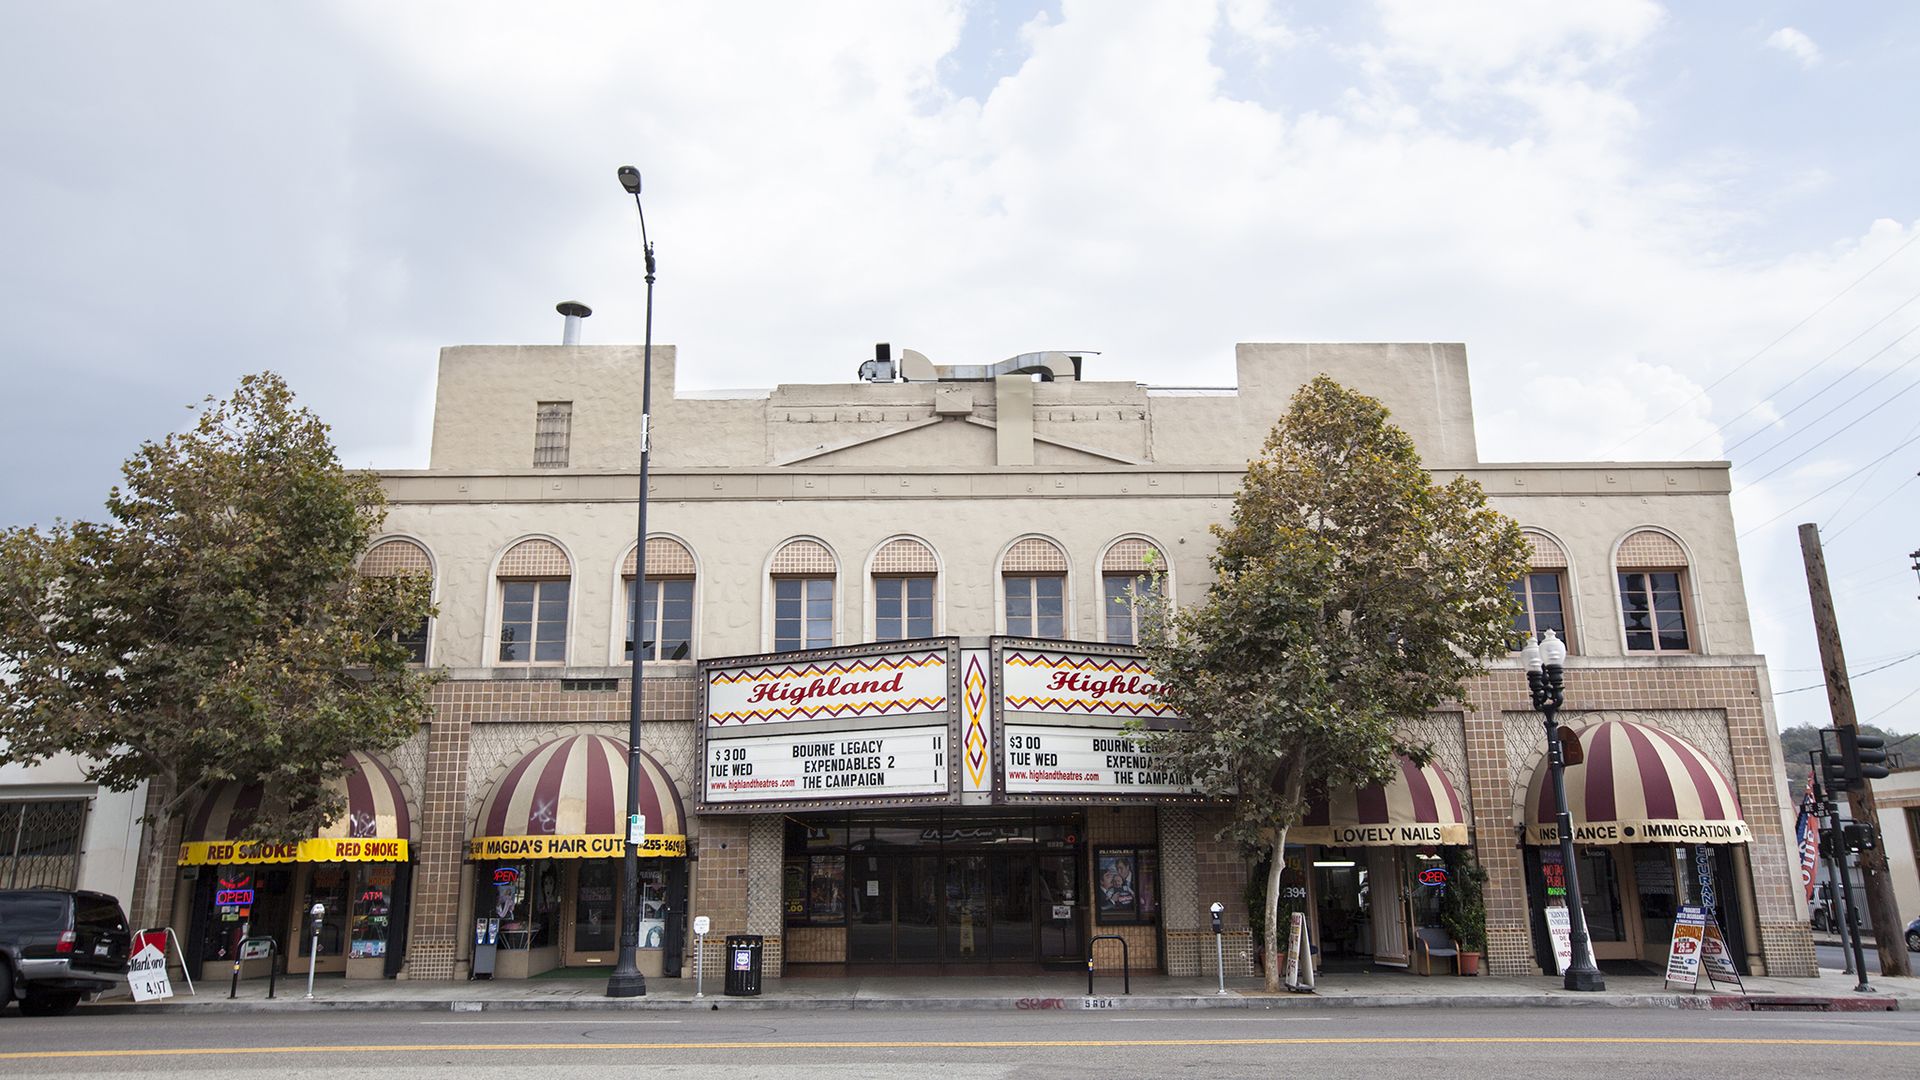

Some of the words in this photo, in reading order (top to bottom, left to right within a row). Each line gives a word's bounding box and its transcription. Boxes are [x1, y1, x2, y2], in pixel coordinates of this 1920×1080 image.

[747, 672, 904, 706] Highland
[1047, 671, 1174, 699] Highlan
[793, 743, 835, 758] BOURNE
[841, 740, 883, 755] LEGACY
[1093, 739, 1134, 753] BOURNE
[805, 756, 881, 773] EXPENDABLES
[888, 755, 895, 769] 2
[1010, 752, 1031, 765] TUE
[1035, 753, 1058, 767] WED
[1106, 755, 1162, 769] EXPENDA
[710, 765, 728, 777] TUE
[732, 763, 753, 776] WED
[803, 775, 822, 789] THE
[825, 772, 885, 788] CAMPAIGN
[1114, 771, 1133, 784] THE
[1138, 772, 1194, 785] CAMPAIGN
[1334, 827, 1396, 843] LOVELY
[1402, 827, 1441, 841] NAILS
[1539, 826, 1618, 841] INSANCE
[1643, 824, 1731, 838] IMMIGRATION
[207, 844, 234, 860] RED
[336, 842, 361, 856] RED
[364, 842, 398, 856] SMOKE
[487, 839, 543, 854] MAGDA'S
[548, 838, 588, 853] HAIR
[493, 871, 518, 881] PEN
[1419, 871, 1447, 883] OPEN
[218, 891, 252, 903] OPEN
[362, 891, 383, 901] ATM
